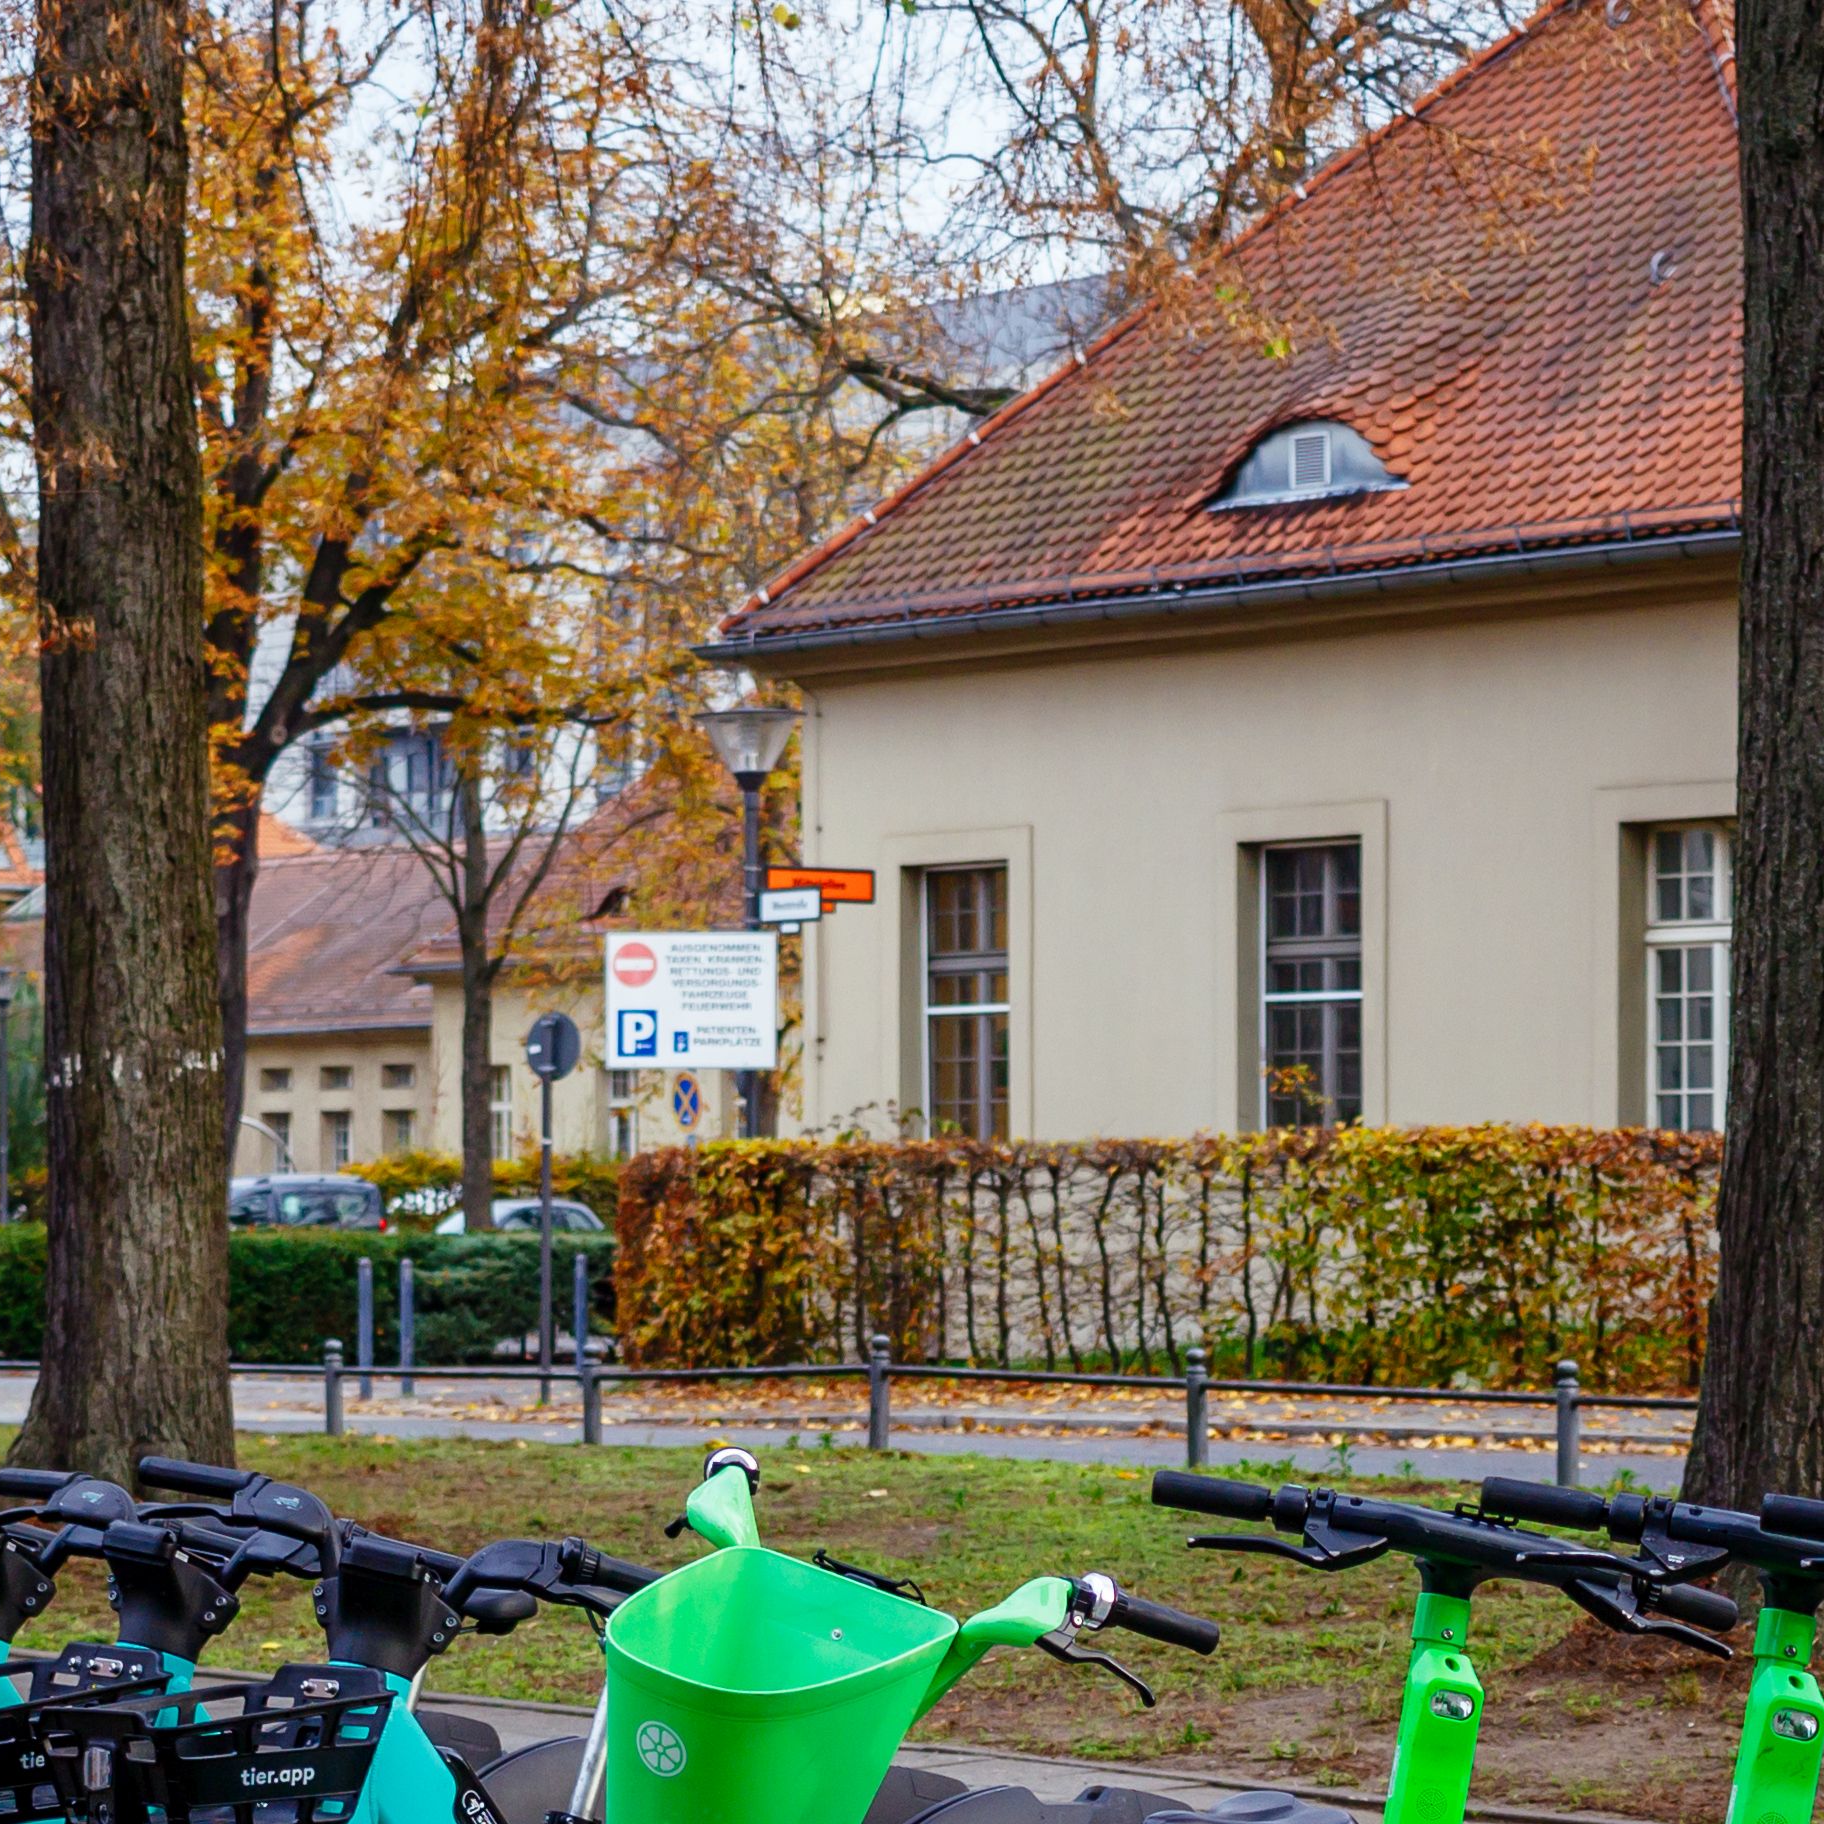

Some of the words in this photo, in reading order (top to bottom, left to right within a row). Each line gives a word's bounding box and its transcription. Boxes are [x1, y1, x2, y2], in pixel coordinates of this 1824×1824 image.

[622, 1013, 655, 1055] P
[20, 1752, 45, 1769] tie
[241, 1765, 316, 1787] tier.app
